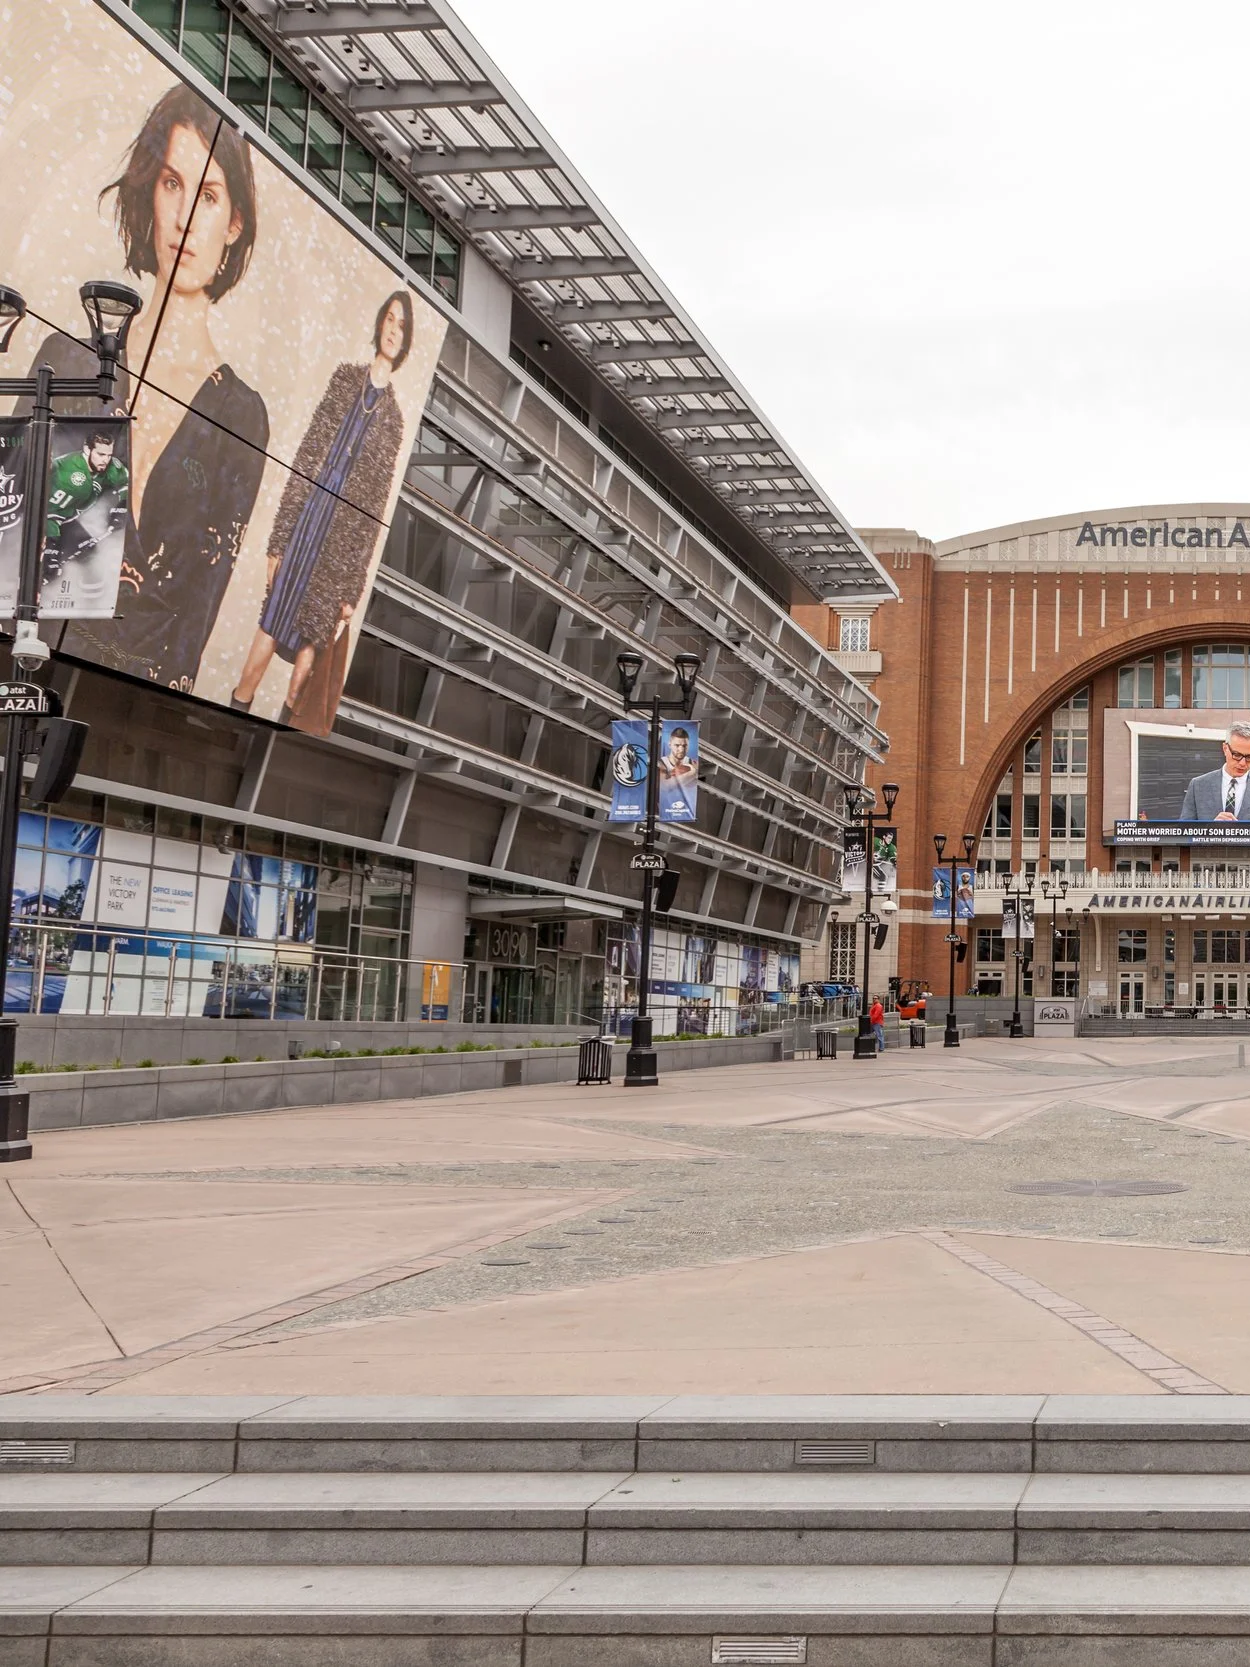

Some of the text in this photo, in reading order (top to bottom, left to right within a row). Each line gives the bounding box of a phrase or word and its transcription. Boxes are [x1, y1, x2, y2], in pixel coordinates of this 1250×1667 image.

[49, 489, 73, 509] 91
[60, 580, 70, 593] 91
[51, 600, 75, 608] SEGUIN
[10, 686, 26, 694] at&t
[1116, 828, 1147, 836] MOTHER
[1149, 828, 1181, 836] WORRIED
[1183, 828, 1208, 836] ABOUT
[1209, 828, 1224, 836] SON
[110, 875, 141, 887] THE NEW
[108, 888, 136, 899] VICTORY
[152, 886, 170, 895] OFFICE
[107, 900, 123, 911] PARK
[492, 929, 528, 958] 3090
